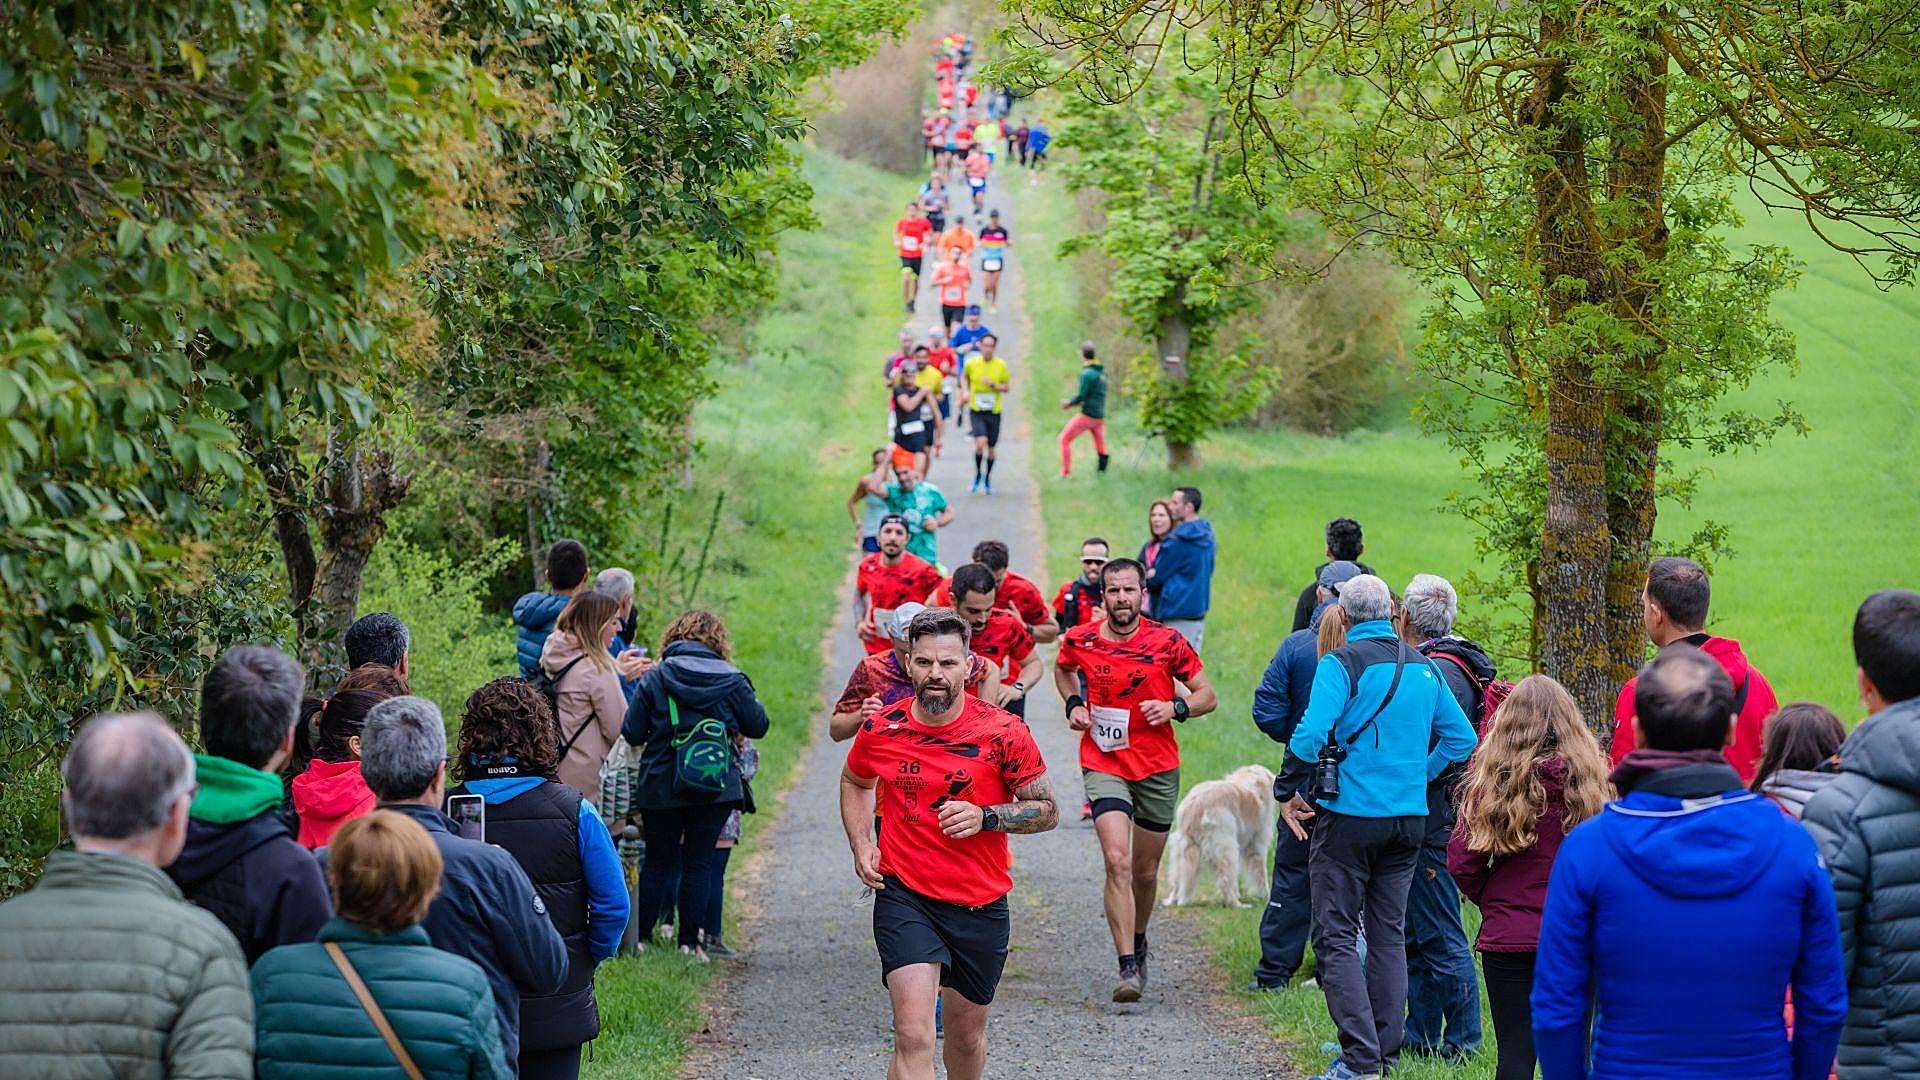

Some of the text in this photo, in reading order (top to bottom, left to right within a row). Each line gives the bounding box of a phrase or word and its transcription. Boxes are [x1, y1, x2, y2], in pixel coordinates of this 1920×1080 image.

[1095, 665, 1110, 674] 36
[1098, 724, 1122, 739] 310
[487, 766, 518, 774] Canon
[898, 760, 921, 774] 36
